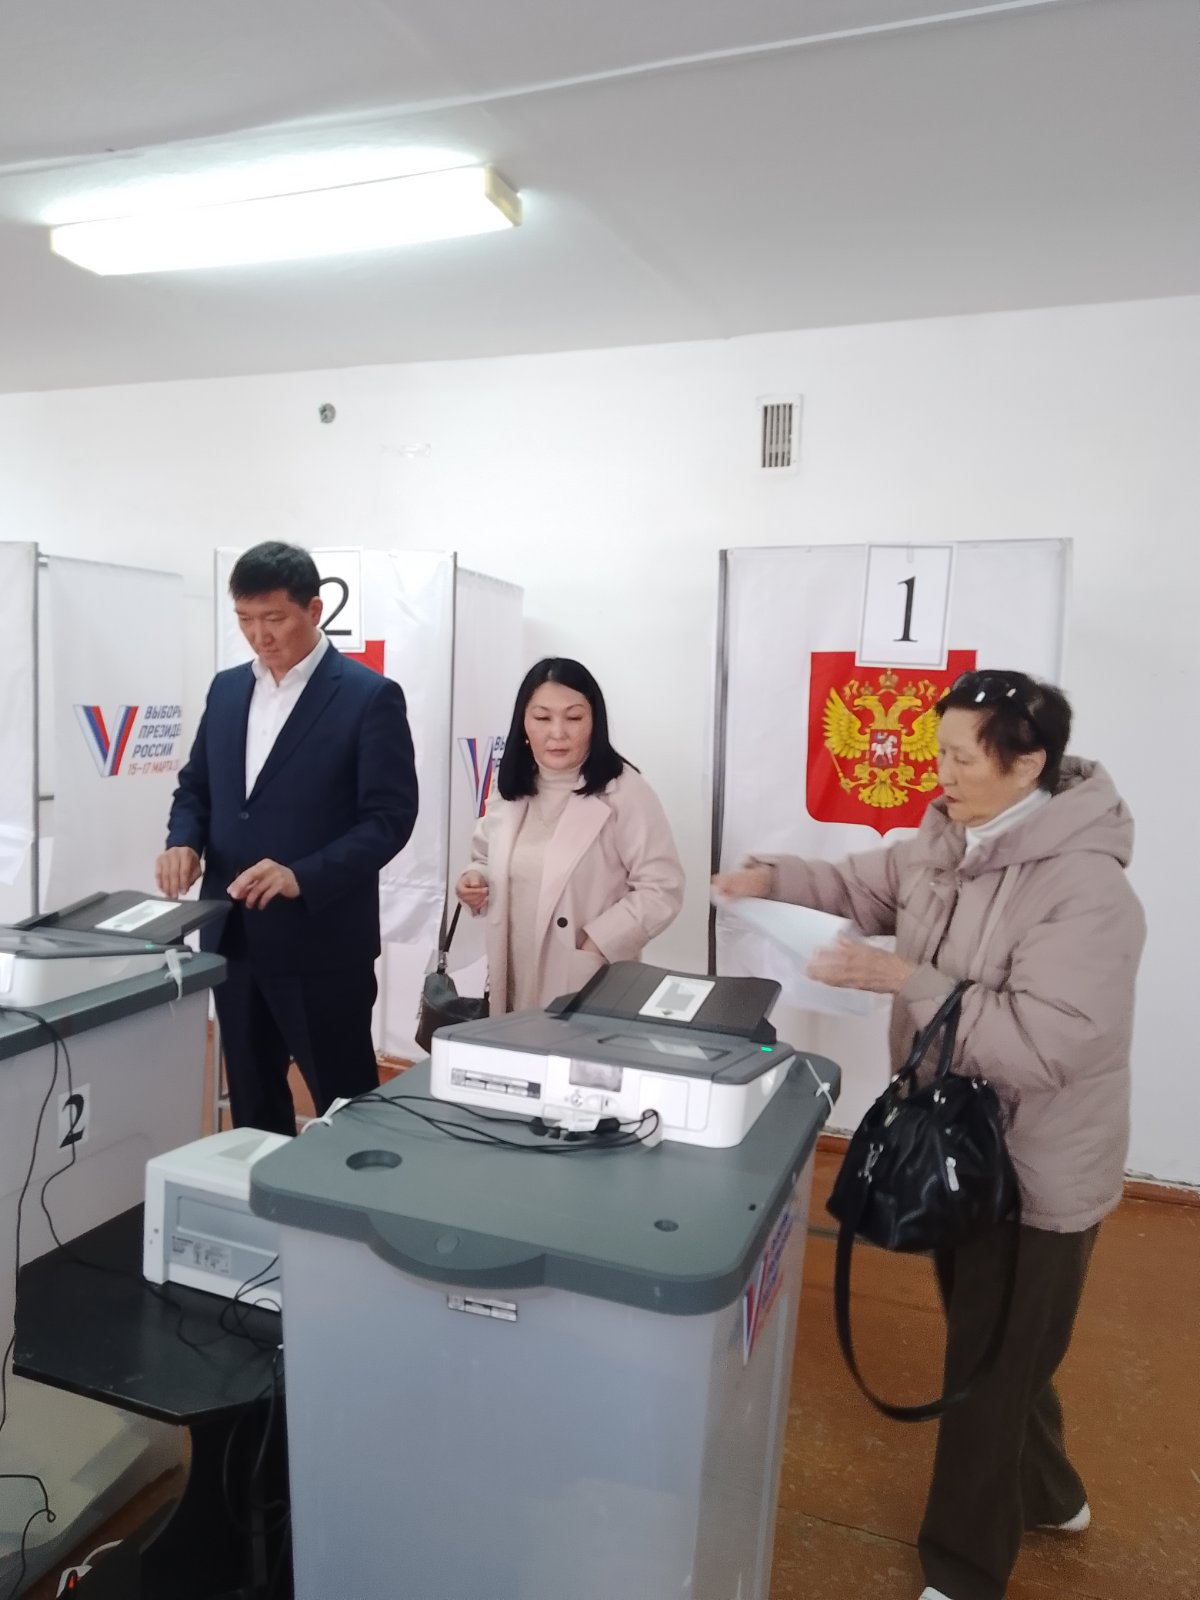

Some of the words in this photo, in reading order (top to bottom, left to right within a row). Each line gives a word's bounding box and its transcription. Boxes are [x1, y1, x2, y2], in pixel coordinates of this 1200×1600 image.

[319, 576, 352, 636] 2
[892, 576, 918, 642] 1
[132, 742, 174, 759] РОССИИ
[60, 1093, 86, 1149] 2
